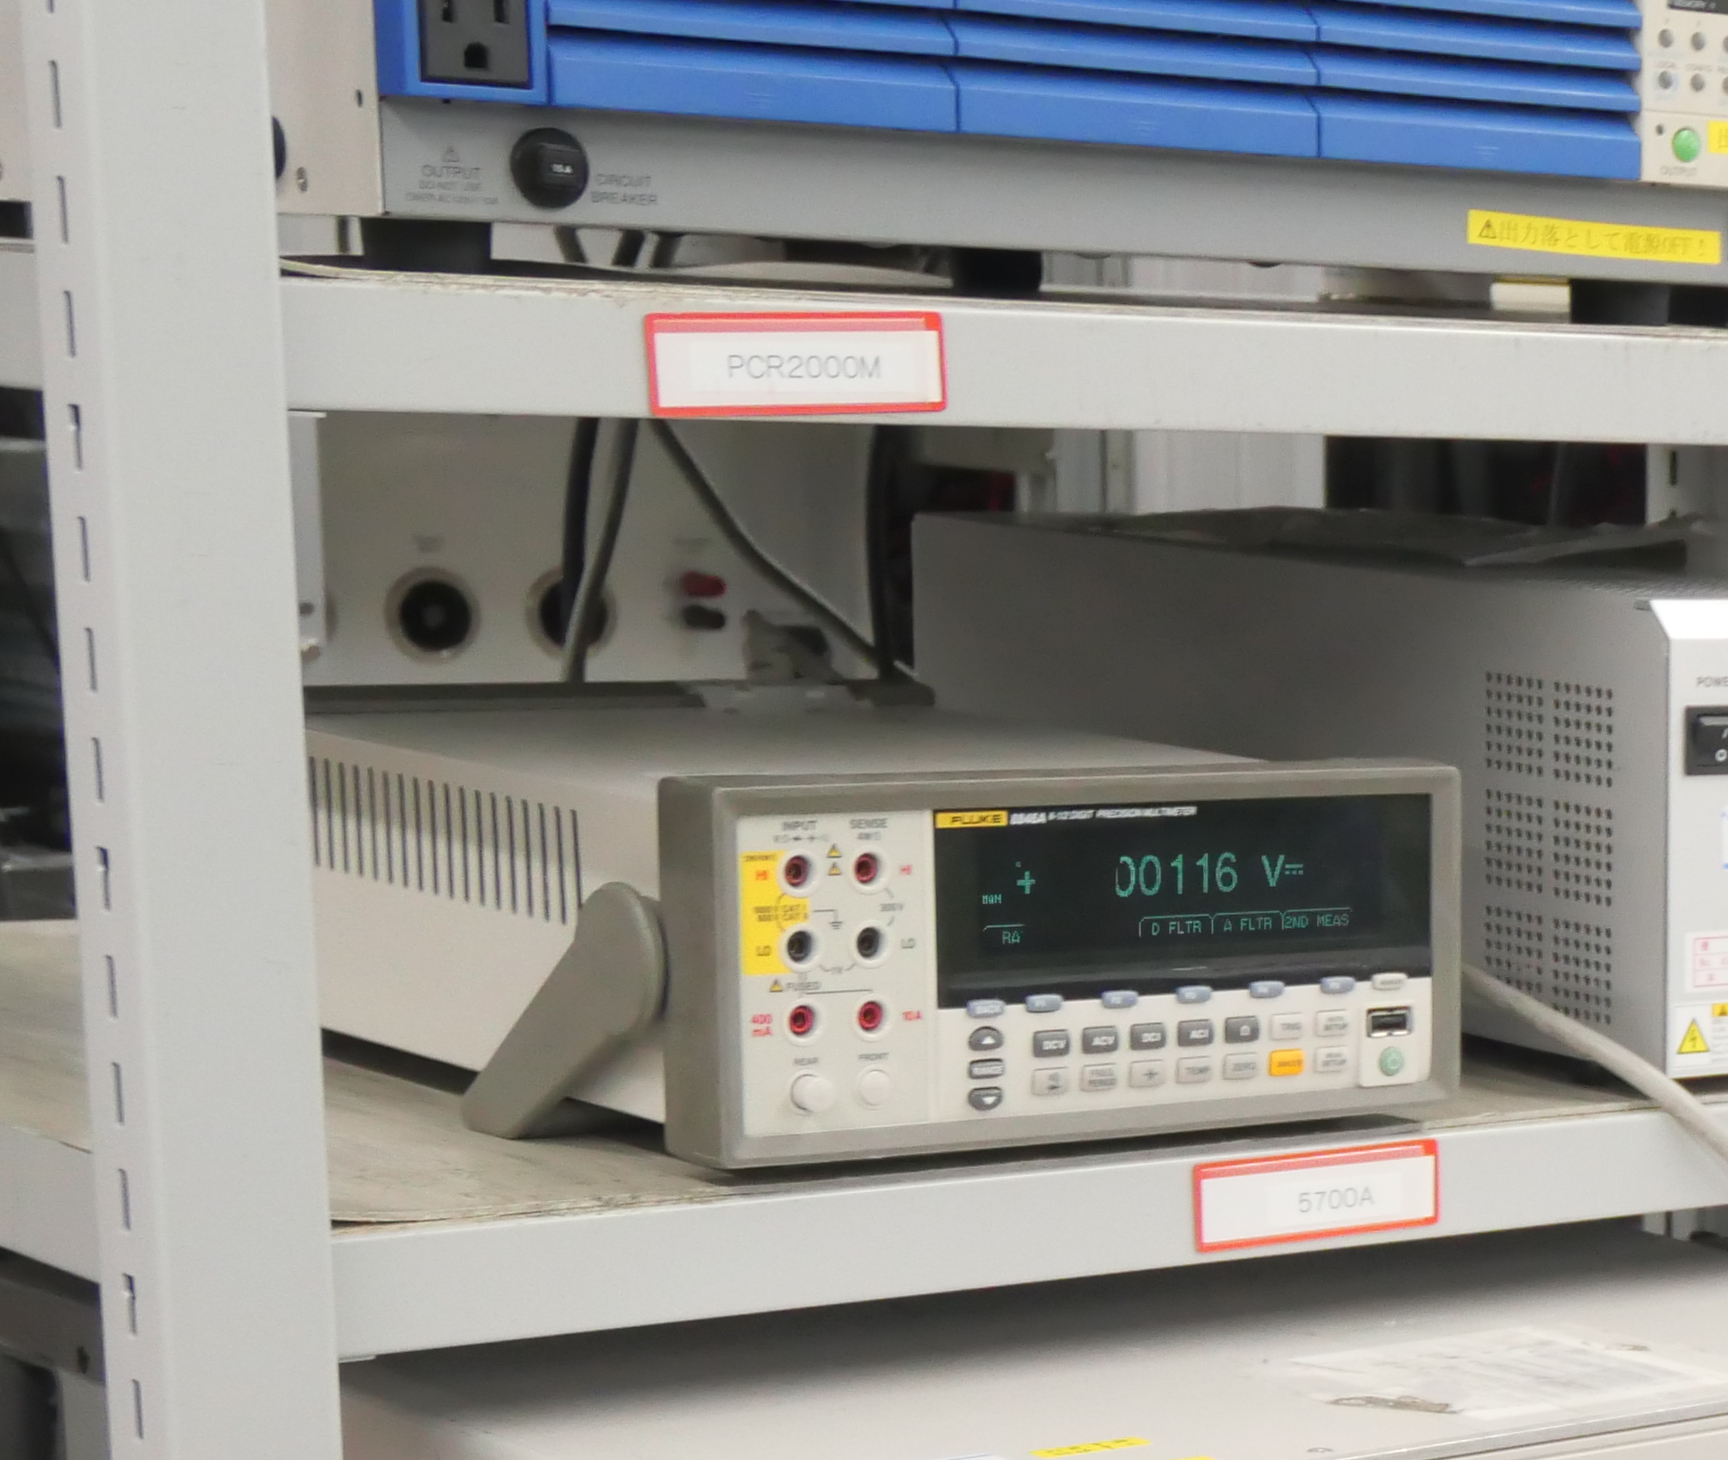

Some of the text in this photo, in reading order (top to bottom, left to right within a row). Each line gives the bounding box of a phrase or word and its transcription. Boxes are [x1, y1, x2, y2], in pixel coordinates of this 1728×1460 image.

[420, 164, 481, 180] OUTPUT
[727, 353, 882, 380] PCR2000M
[849, 817, 888, 830] SENSE
[950, 813, 1004, 826] FLUKE
[981, 893, 1003, 905] MAN
[1168, 920, 1203, 935] FLTR
[1239, 916, 1273, 931] FLTR
[1284, 912, 1350, 930] 2ND MEAS
[793, 1056, 820, 1067] REAR
[858, 1051, 890, 1062] FRONT
[1298, 1185, 1376, 1214] 5700A
